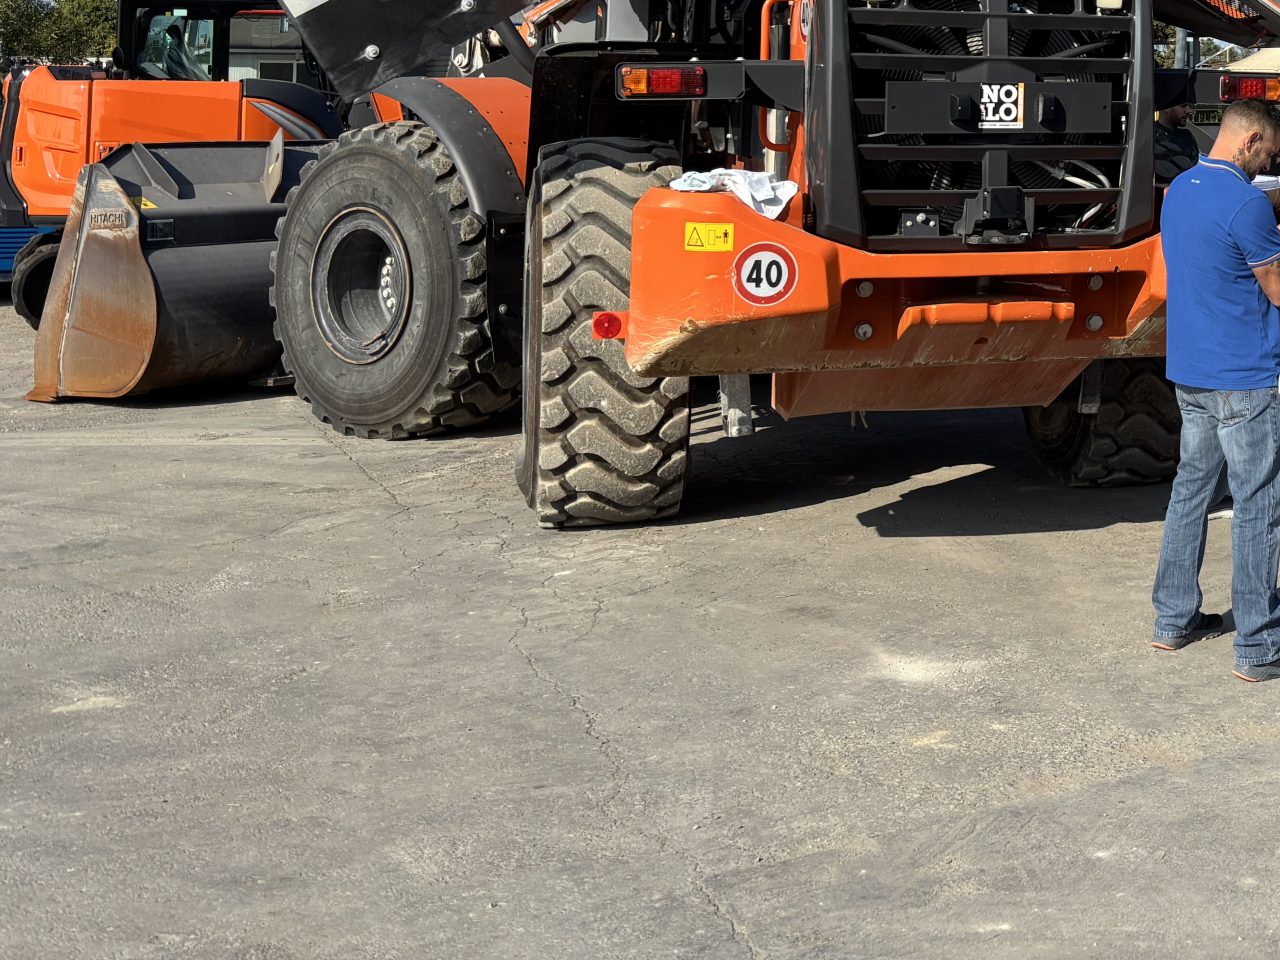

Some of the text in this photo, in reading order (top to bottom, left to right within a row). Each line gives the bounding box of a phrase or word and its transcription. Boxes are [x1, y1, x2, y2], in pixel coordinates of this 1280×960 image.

[981, 84, 1018, 103] NO
[985, 102, 1018, 121] LO
[90, 212, 123, 224] HITACHI
[746, 259, 783, 288] 40
